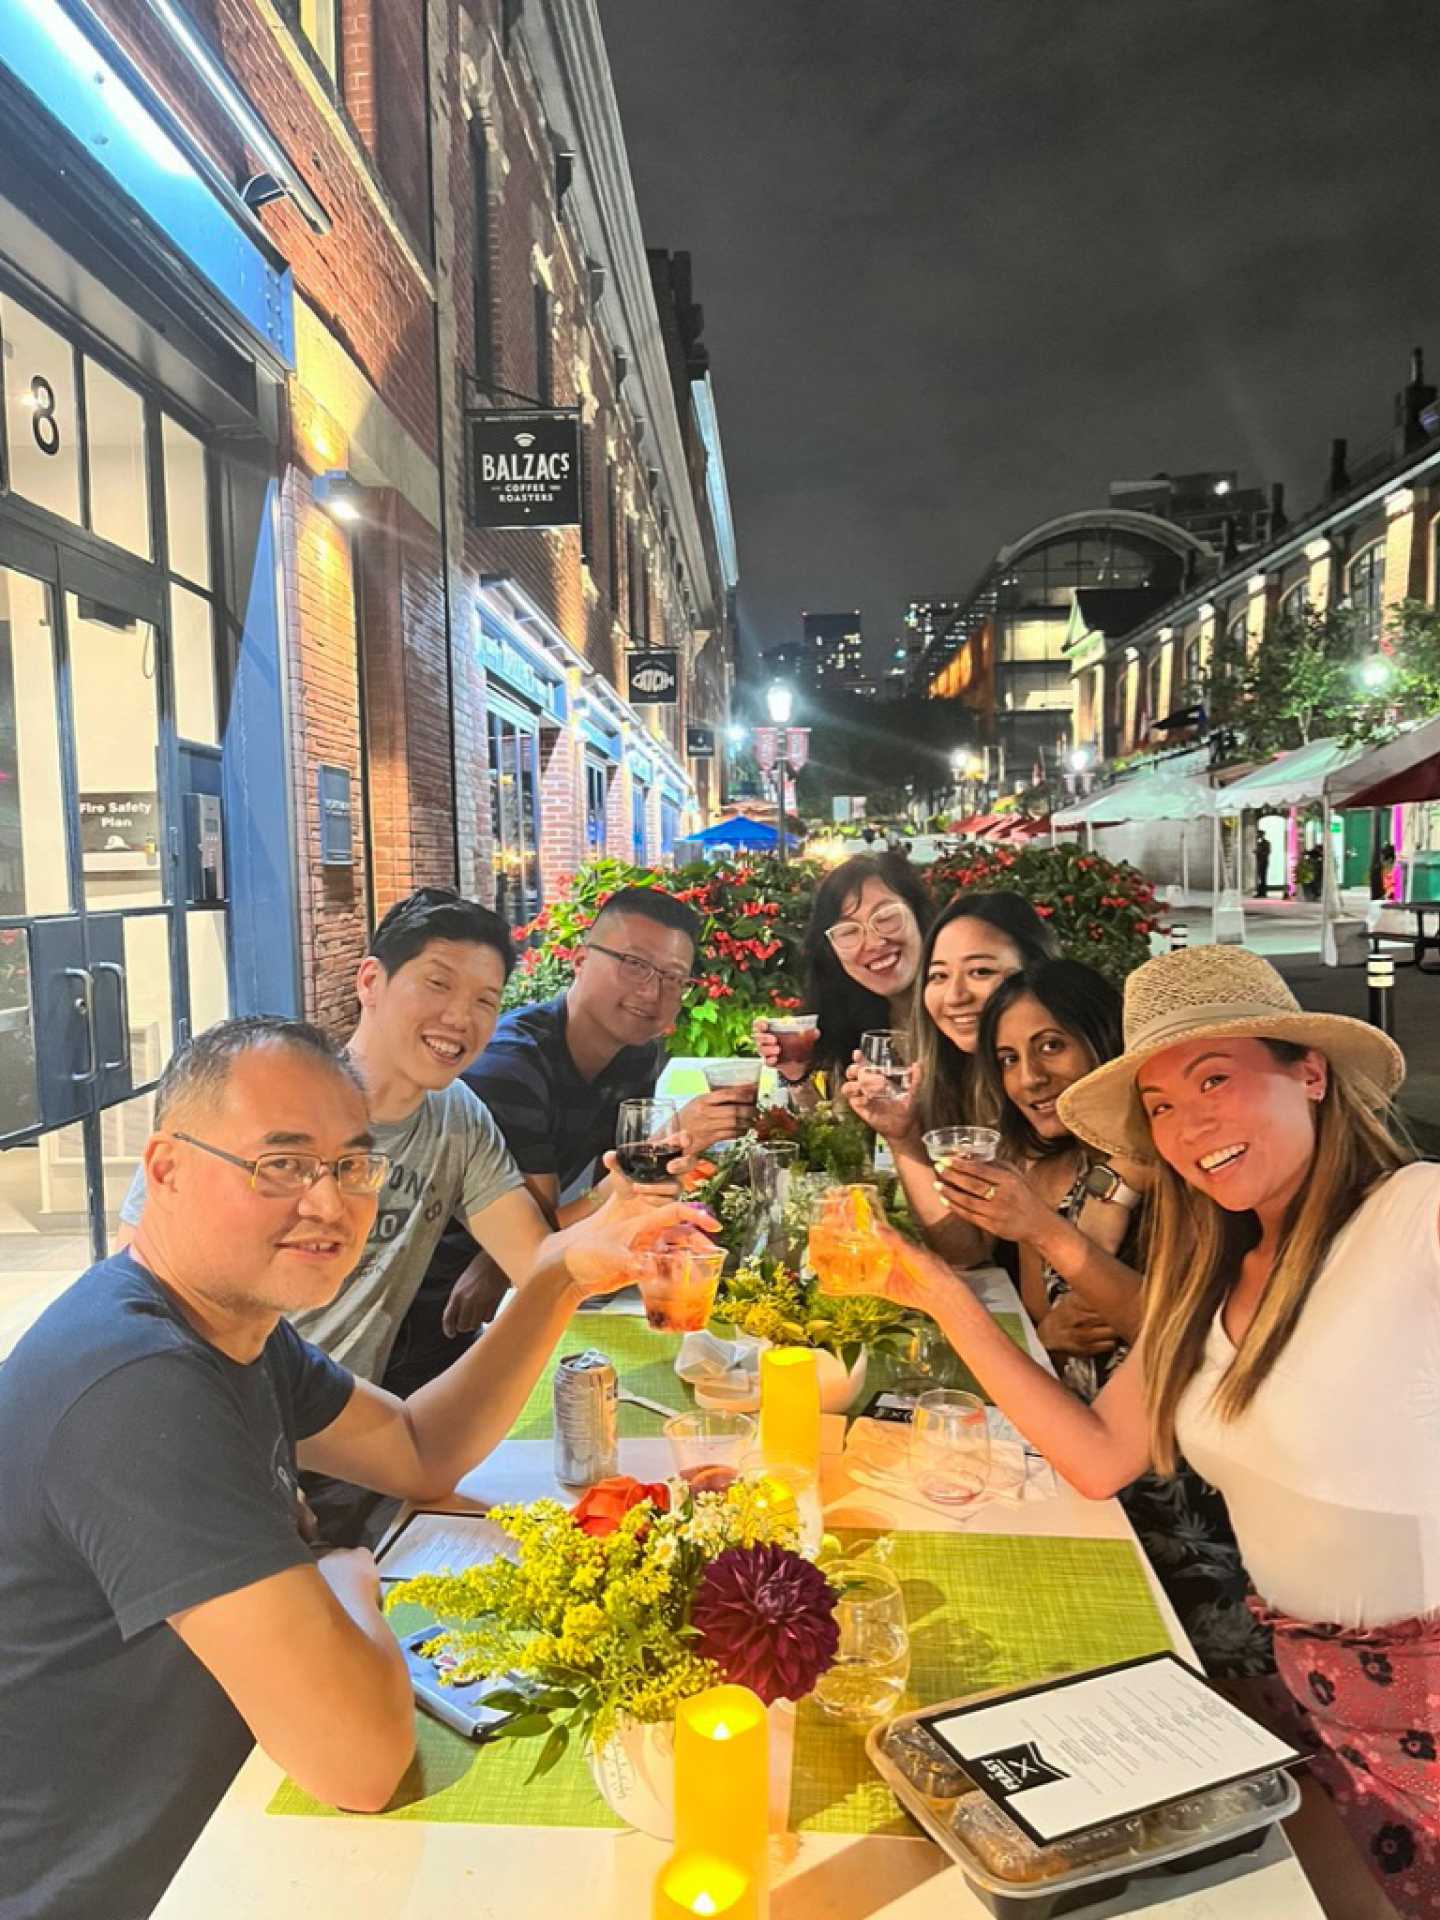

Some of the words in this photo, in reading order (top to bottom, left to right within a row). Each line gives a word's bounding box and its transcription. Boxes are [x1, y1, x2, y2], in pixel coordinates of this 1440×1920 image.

[31, 375, 59, 456] 8
[505, 483, 545, 492] COFFEE
[499, 493, 553, 502] ROASTERS
[79, 801, 105, 813] Fire
[109, 801, 152, 815] Safety
[101, 817, 133, 828] Plan
